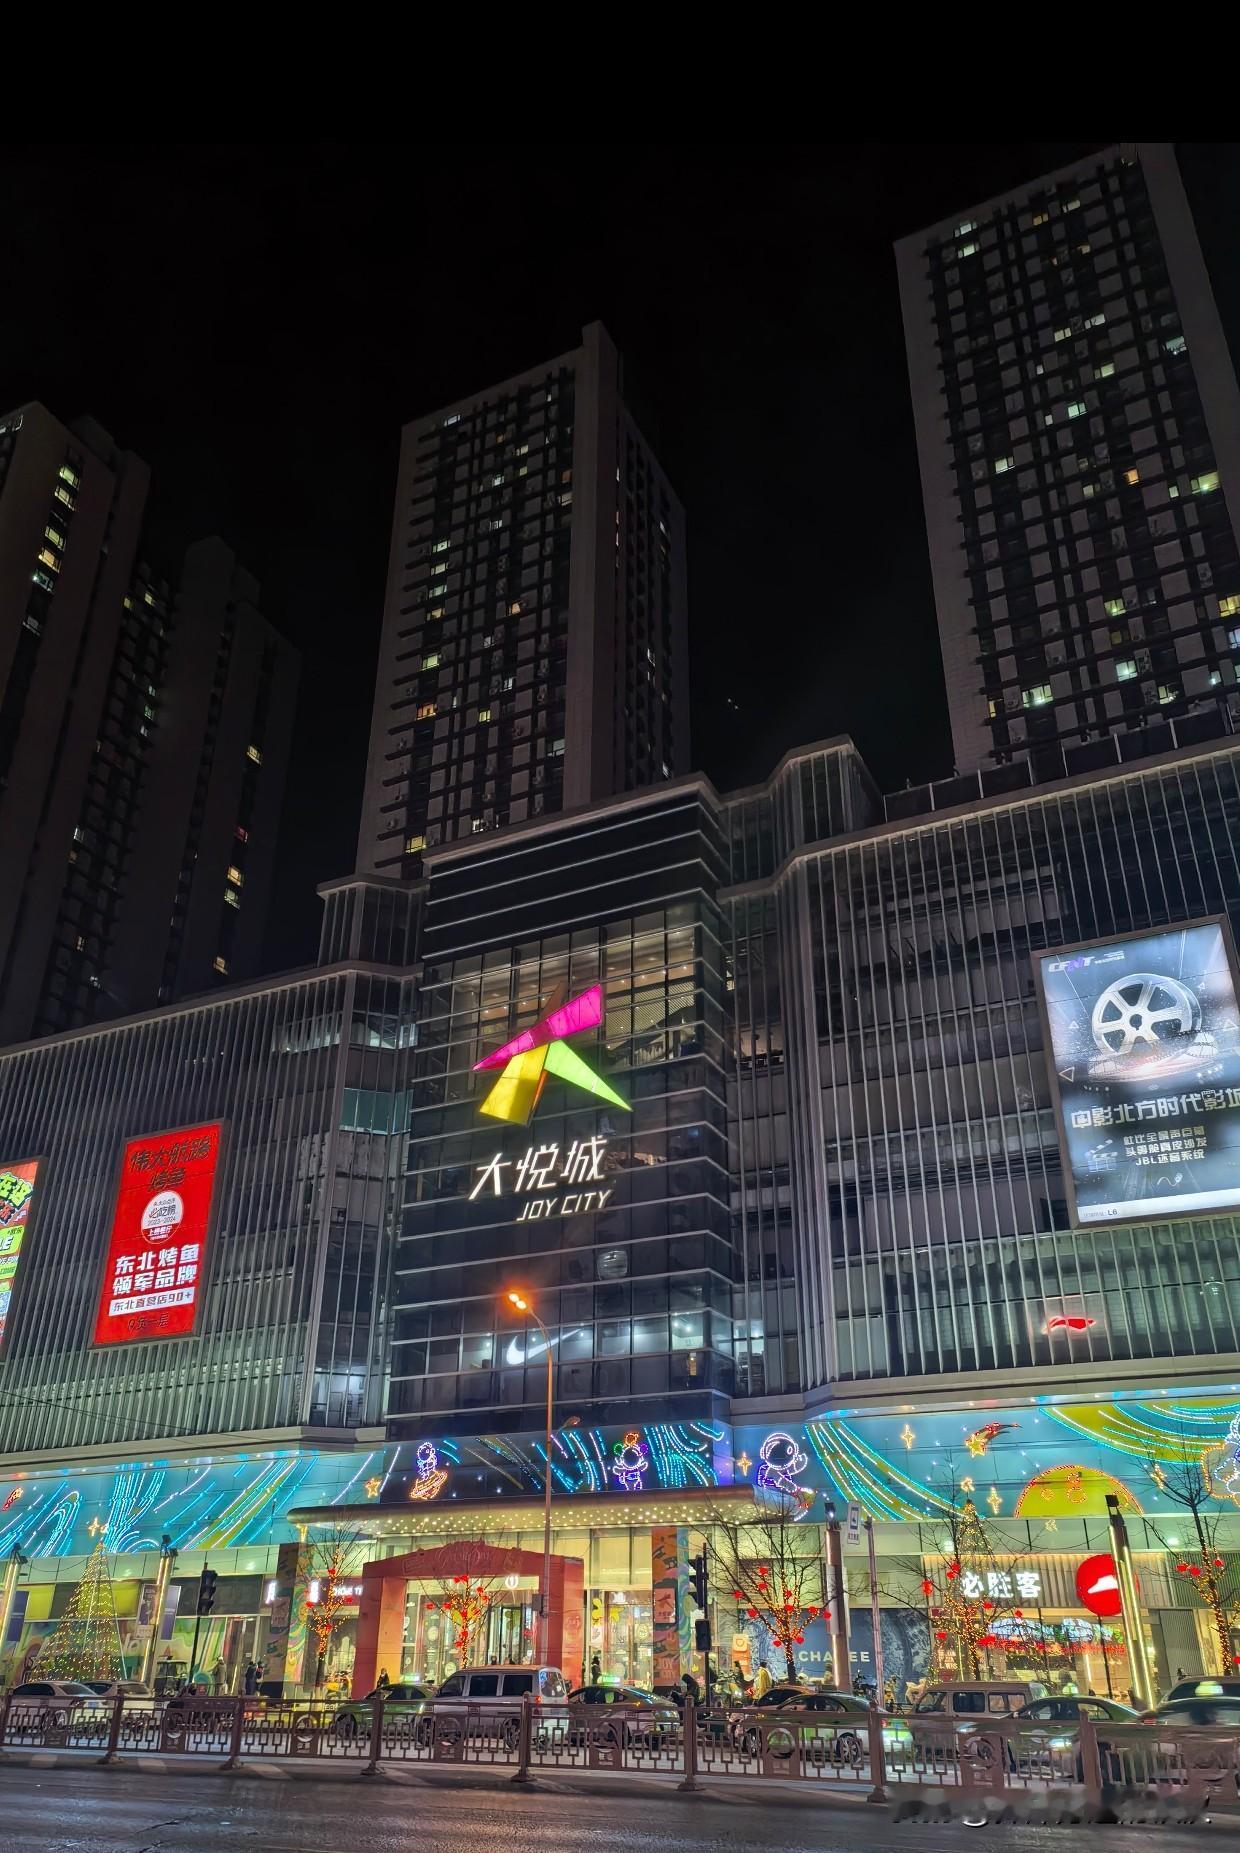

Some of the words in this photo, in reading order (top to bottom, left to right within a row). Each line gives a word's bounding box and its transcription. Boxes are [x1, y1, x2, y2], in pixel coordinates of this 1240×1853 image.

[468, 1135, 609, 1200] 大悦城
[149, 1204, 177, 1219] 必吃榜
[516, 1197, 557, 1222] JOY
[561, 1189, 614, 1215] CITY
[115, 1244, 200, 1275] 东北烤鱼
[112, 1265, 198, 1296] 领军品牌
[113, 1291, 192, 1312] 东北直营店90+
[960, 1571, 1041, 1598] 必胜客
[798, 1650, 871, 1662] CHAEE
